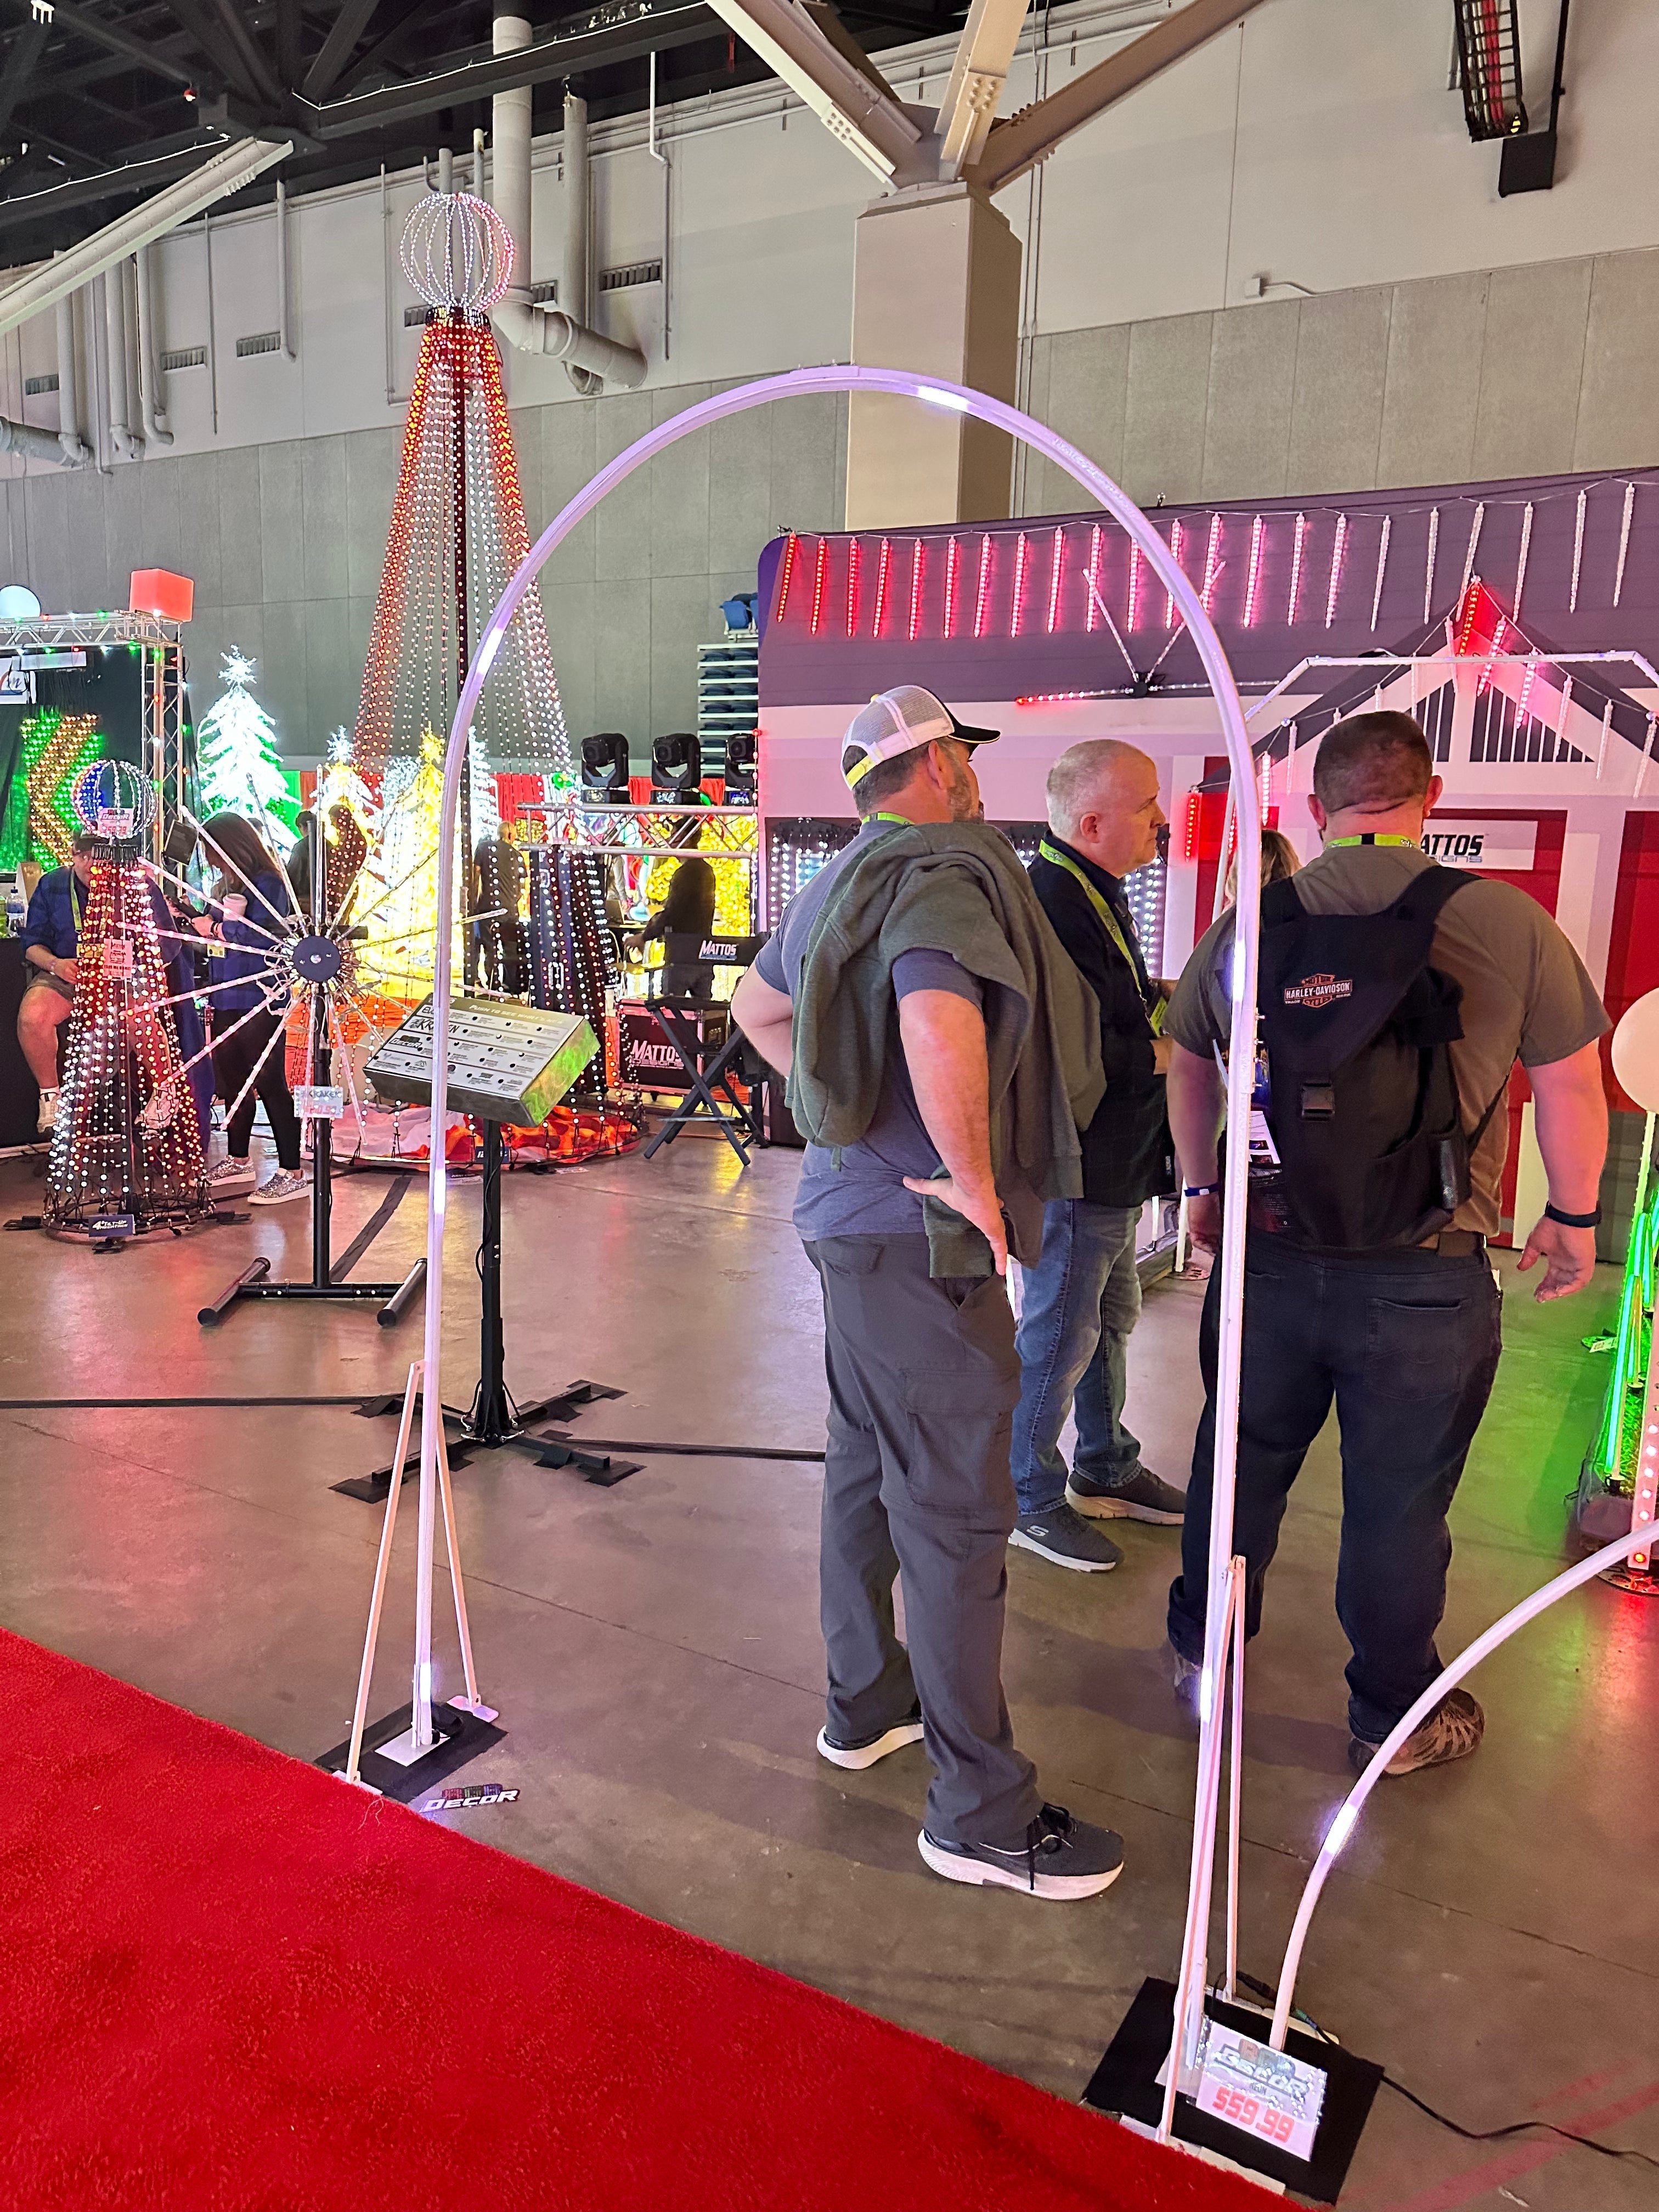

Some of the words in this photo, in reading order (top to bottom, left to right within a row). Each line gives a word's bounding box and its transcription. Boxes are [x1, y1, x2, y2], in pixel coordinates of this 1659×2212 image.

[1420, 834, 1484, 856] ATTOS
[698, 940, 737, 957] MATTOS
[1286, 982, 1351, 999] HARLEY-DAVIDSON
[390, 1038, 422, 1048] DECOR
[419, 1790, 518, 1813] DECOR
